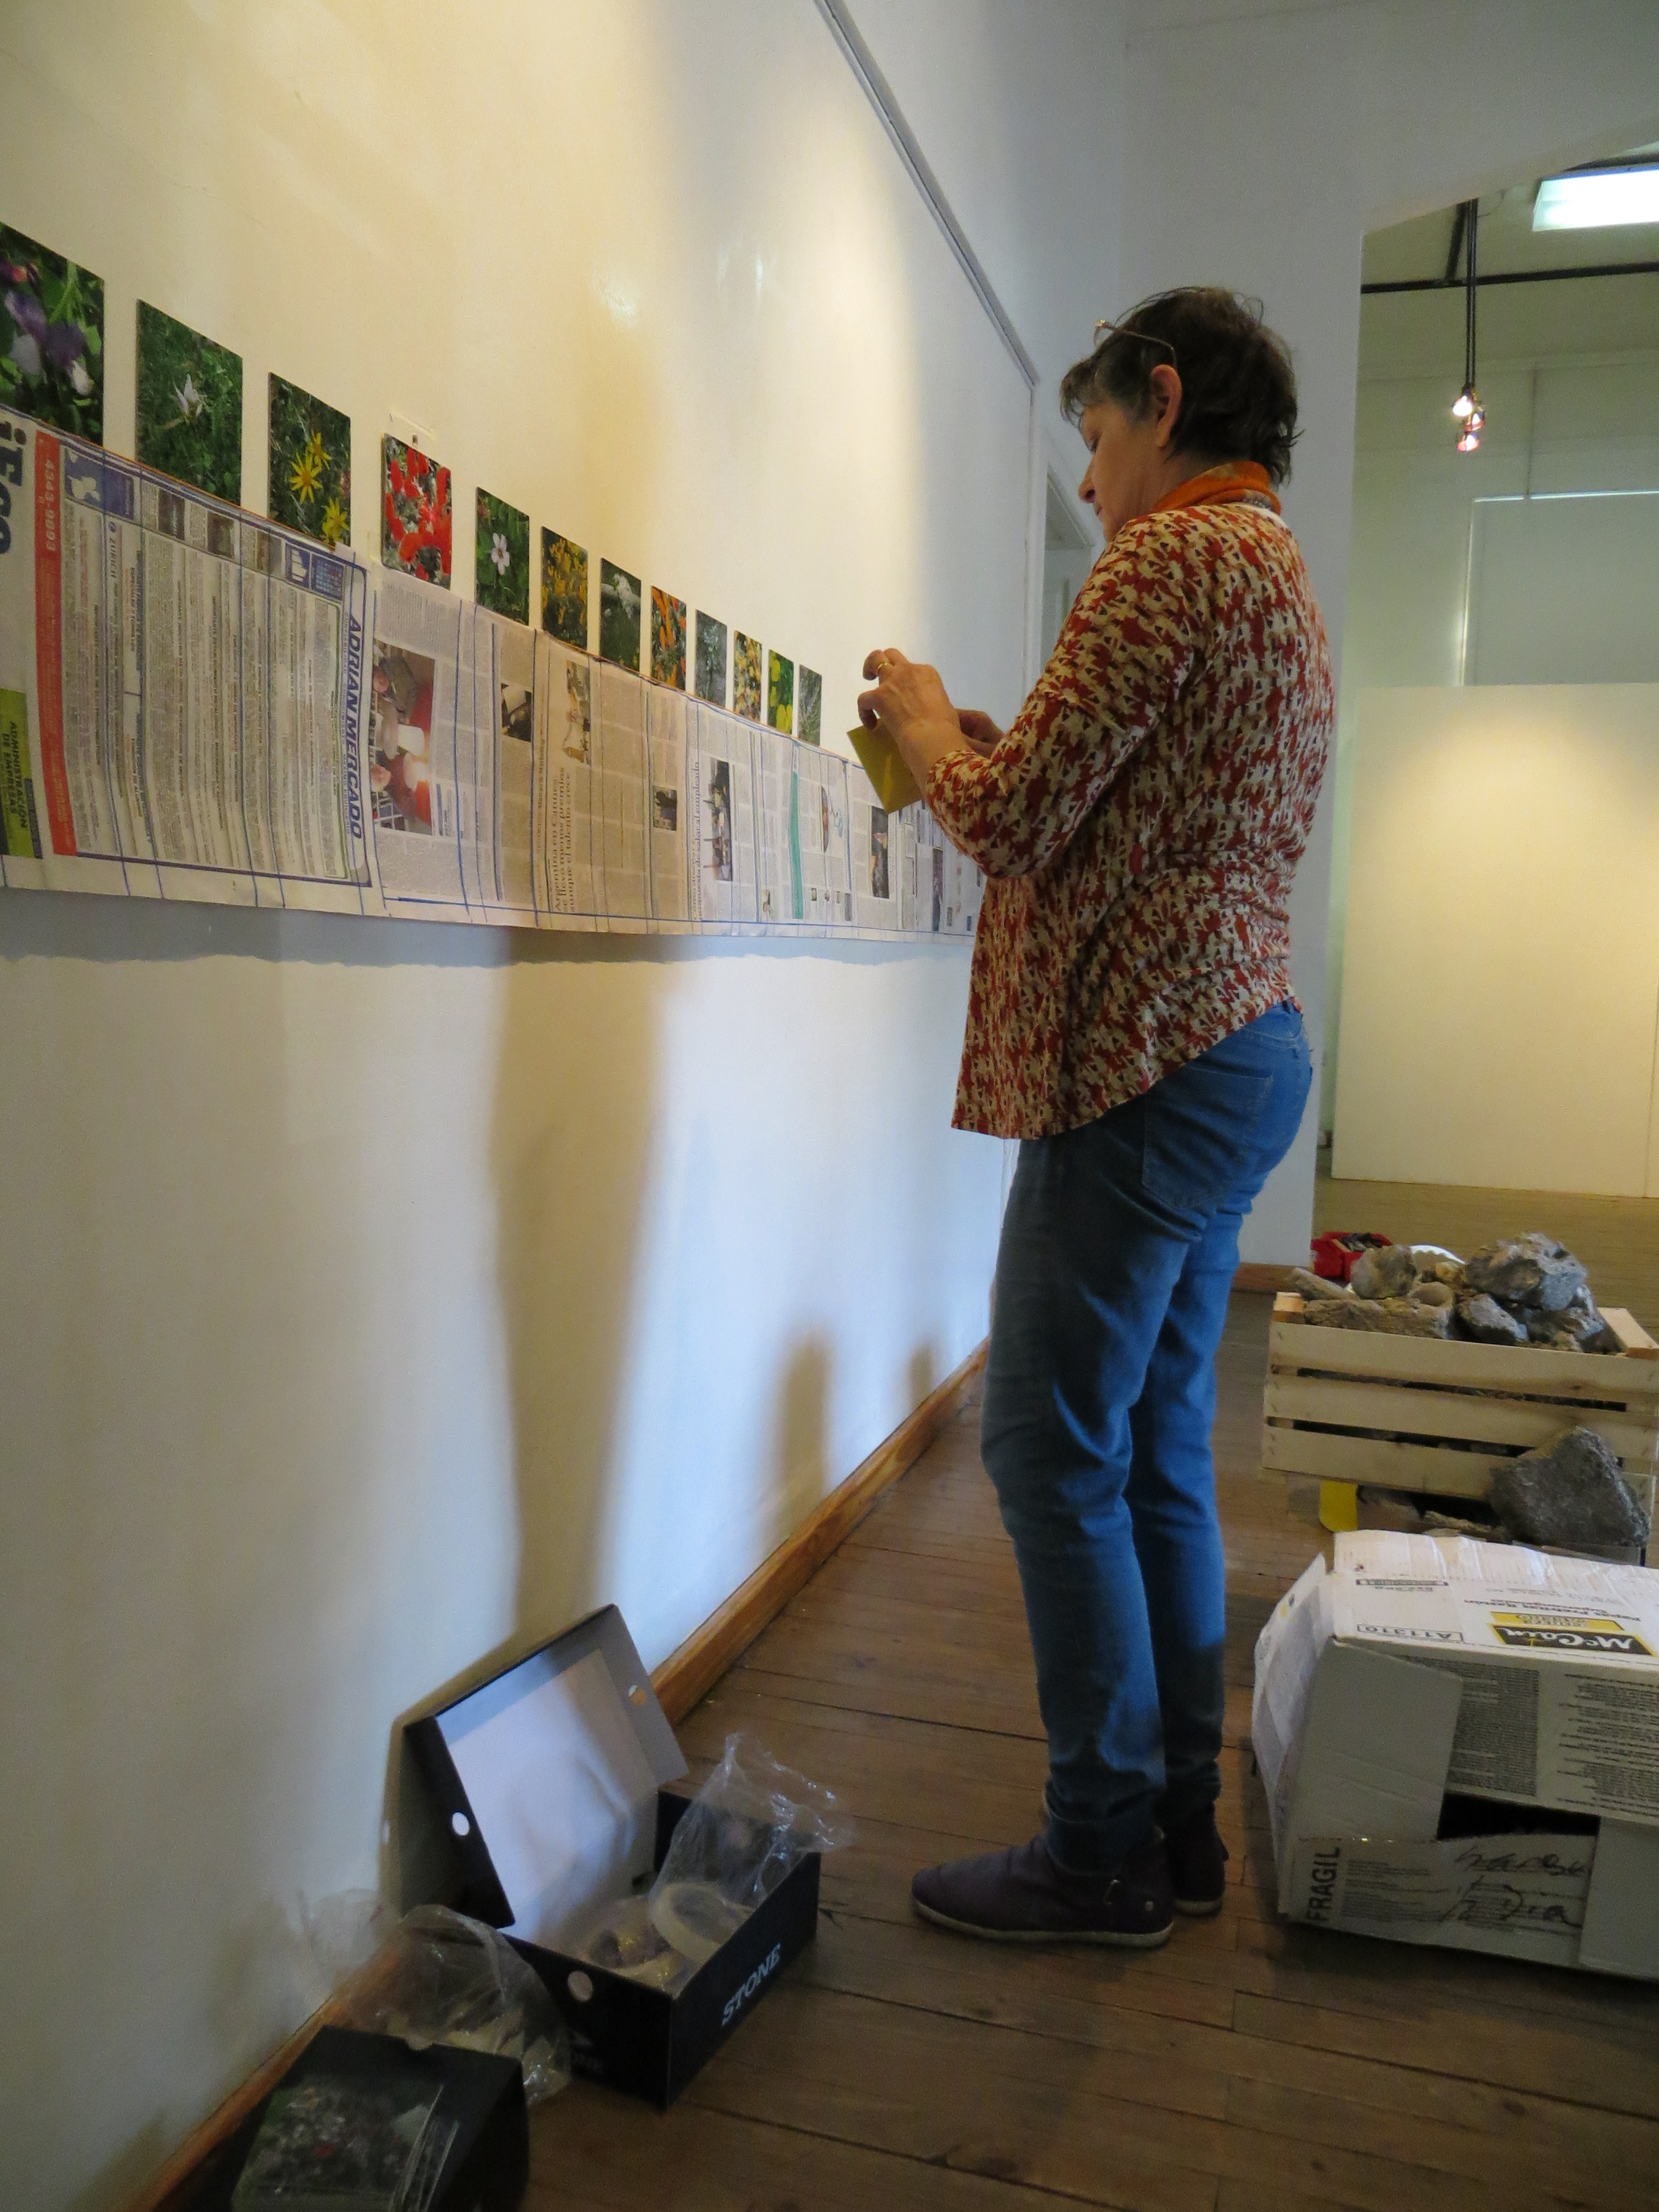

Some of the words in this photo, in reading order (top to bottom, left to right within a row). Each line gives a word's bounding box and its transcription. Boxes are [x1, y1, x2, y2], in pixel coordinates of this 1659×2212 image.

[347, 614, 362, 713] ADRIAN
[346, 714, 363, 839] MERCADO
[691, 761, 701, 815] empleado
[552, 849, 561, 912] Argentina
[1494, 1627, 1634, 1650] McCain
[1305, 1847, 1340, 1922] FRAGIL
[721, 1942, 781, 2027] STONE
